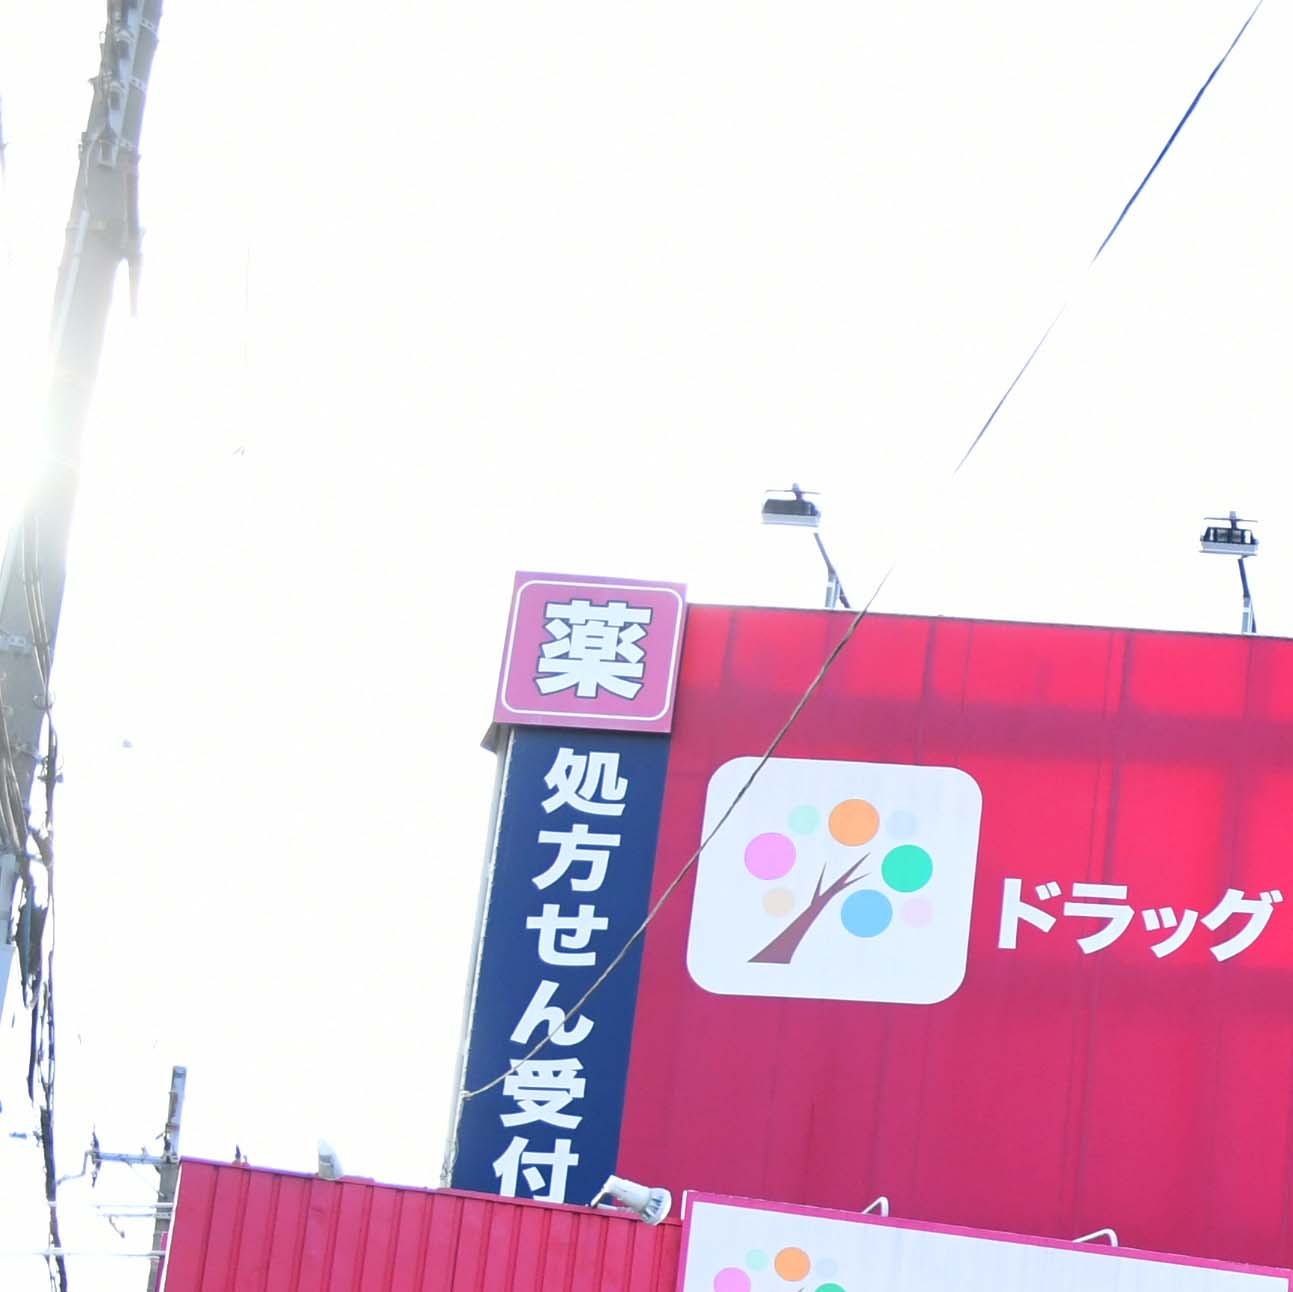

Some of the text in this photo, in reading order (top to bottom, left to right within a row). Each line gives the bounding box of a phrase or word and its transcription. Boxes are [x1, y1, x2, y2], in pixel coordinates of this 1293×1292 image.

[534, 598, 652, 700] 薬
[998, 876, 1284, 963] ドラッグ
[492, 747, 628, 1205] 処方せん受付
